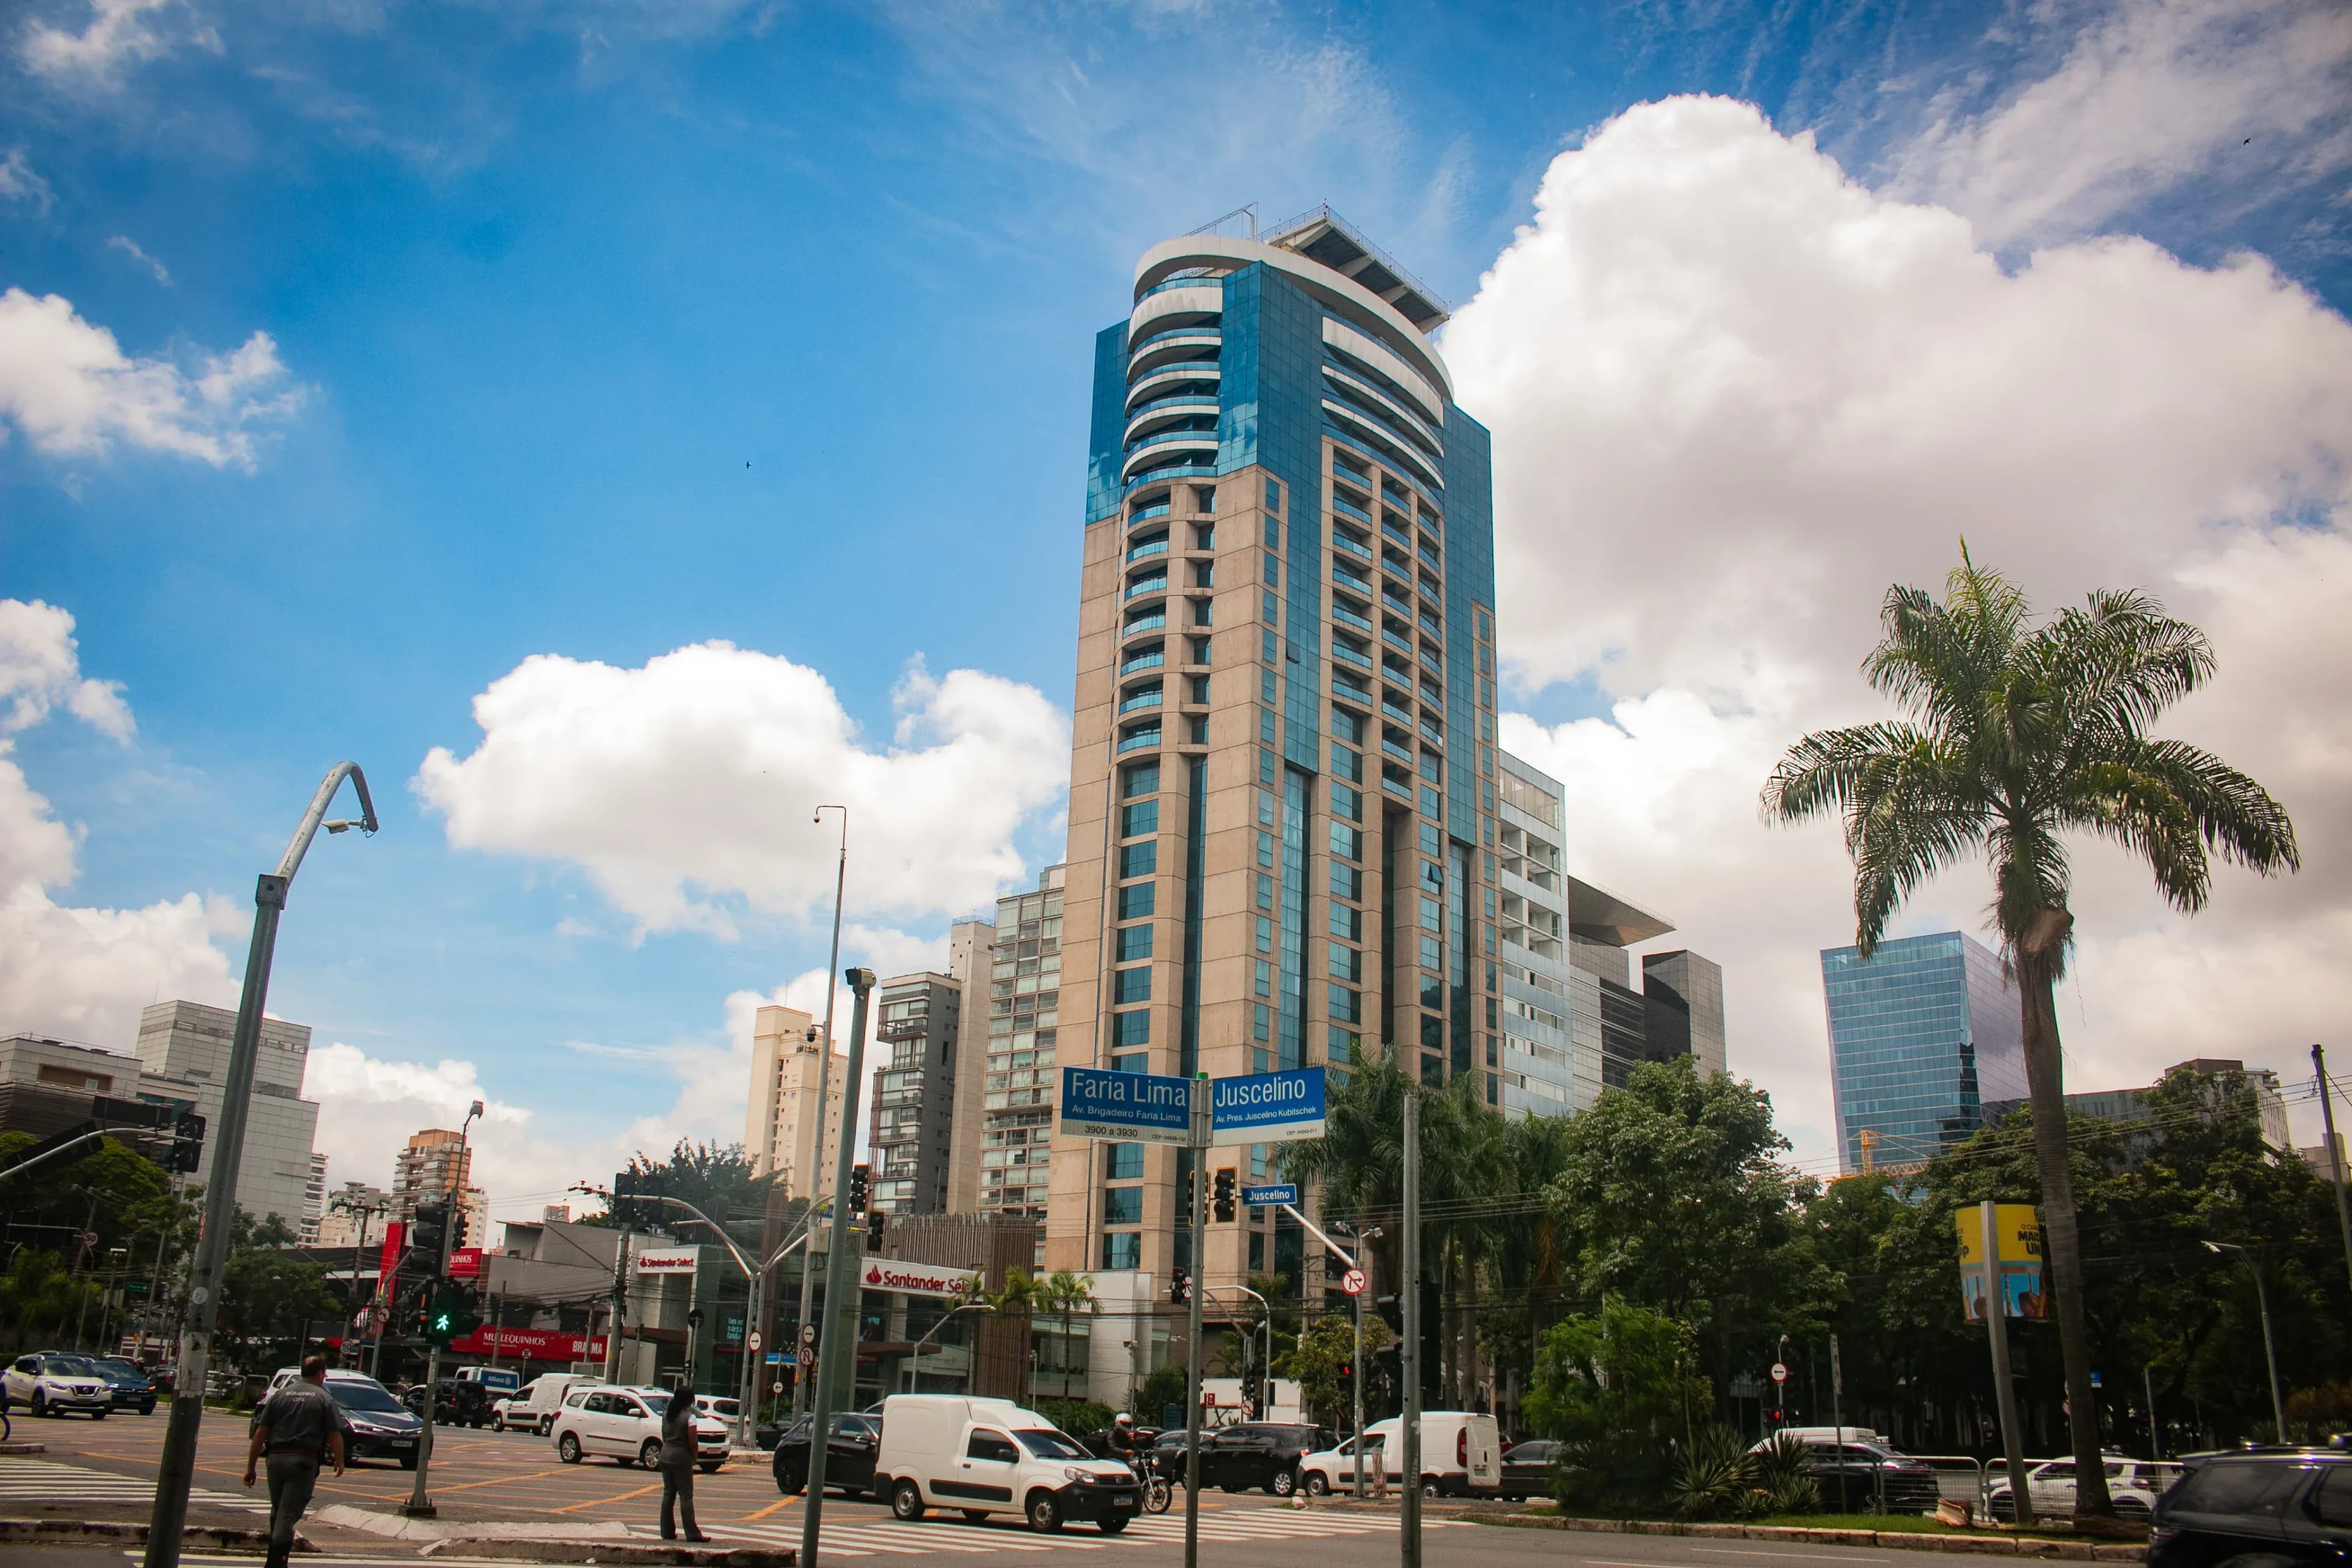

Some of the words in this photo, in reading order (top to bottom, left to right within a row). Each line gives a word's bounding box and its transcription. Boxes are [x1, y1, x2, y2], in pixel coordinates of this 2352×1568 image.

[1072, 1072, 1125, 1101] Faria
[1134, 1078, 1186, 1107] Lima
[1216, 1076, 1305, 1107] Juscelino
[1072, 1105, 1085, 1114] Av.
[1088, 1106, 1133, 1118] Brigadeiro
[1136, 1110, 1158, 1120] Faria
[1160, 1113, 1182, 1122] Lima
[1245, 1110, 1277, 1121] Juscelino
[1278, 1106, 1316, 1117] Kubitschek
[1085, 1125, 1107, 1134] 3900
[1117, 1128, 1138, 1137] 3930
[1248, 1189, 1290, 1200] Juscelino
[647, 1258, 677, 1267] Santander
[677, 1257, 694, 1267] Select
[884, 1270, 946, 1292] Santander
[948, 1278, 966, 1294] Sel
[483, 1332, 546, 1346] MULEQUINHOS
[573, 1341, 603, 1354] BRAMA
